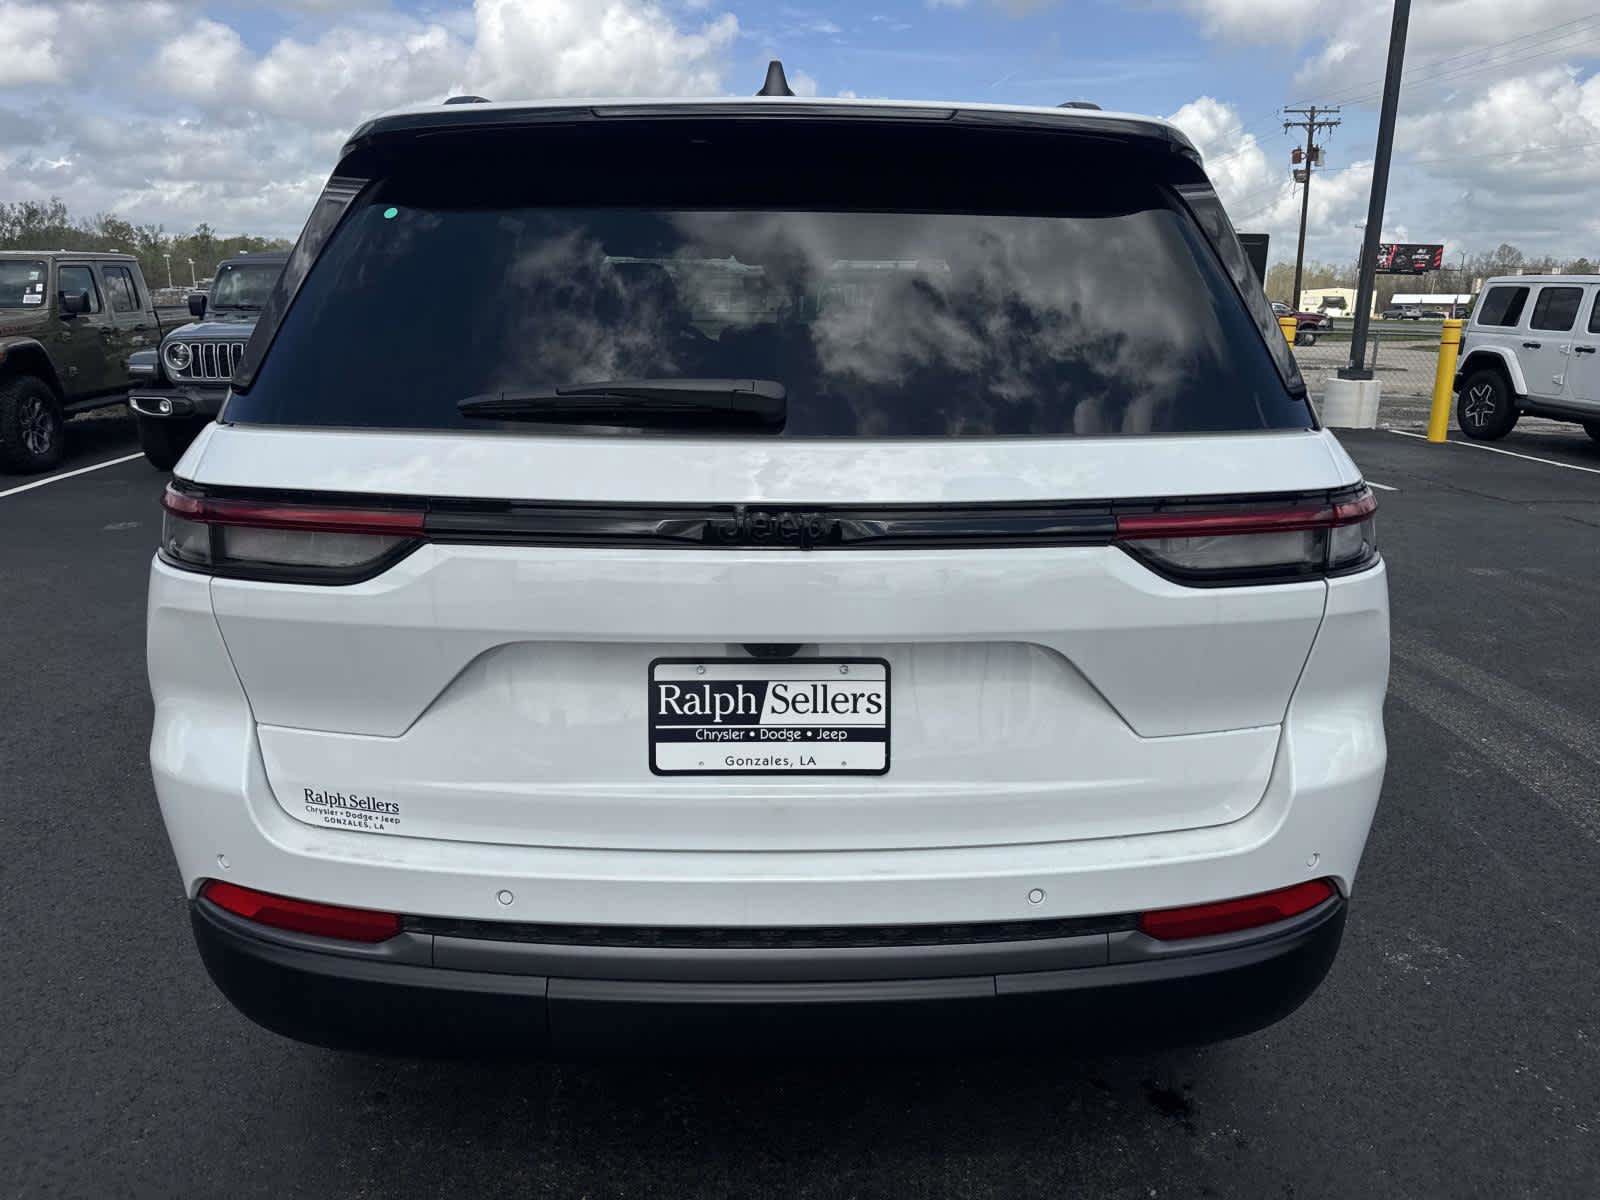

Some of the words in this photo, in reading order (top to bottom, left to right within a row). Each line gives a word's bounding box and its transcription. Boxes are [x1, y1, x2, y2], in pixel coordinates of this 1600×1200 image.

[718, 504, 831, 550] Jeep
[658, 684, 758, 723] Ralph
[771, 683, 882, 715] Sellers
[695, 728, 745, 742] Chrysler
[760, 728, 801, 742] Dodge
[816, 728, 848, 742] Jeep
[725, 756, 794, 767] Gonzales,
[800, 756, 817, 766] LA
[304, 788, 347, 808] Ralph
[349, 794, 400, 813] Sellers
[305, 805, 338, 816] Chrysler
[345, 811, 373, 821] Dodge
[381, 816, 401, 824] Jeep
